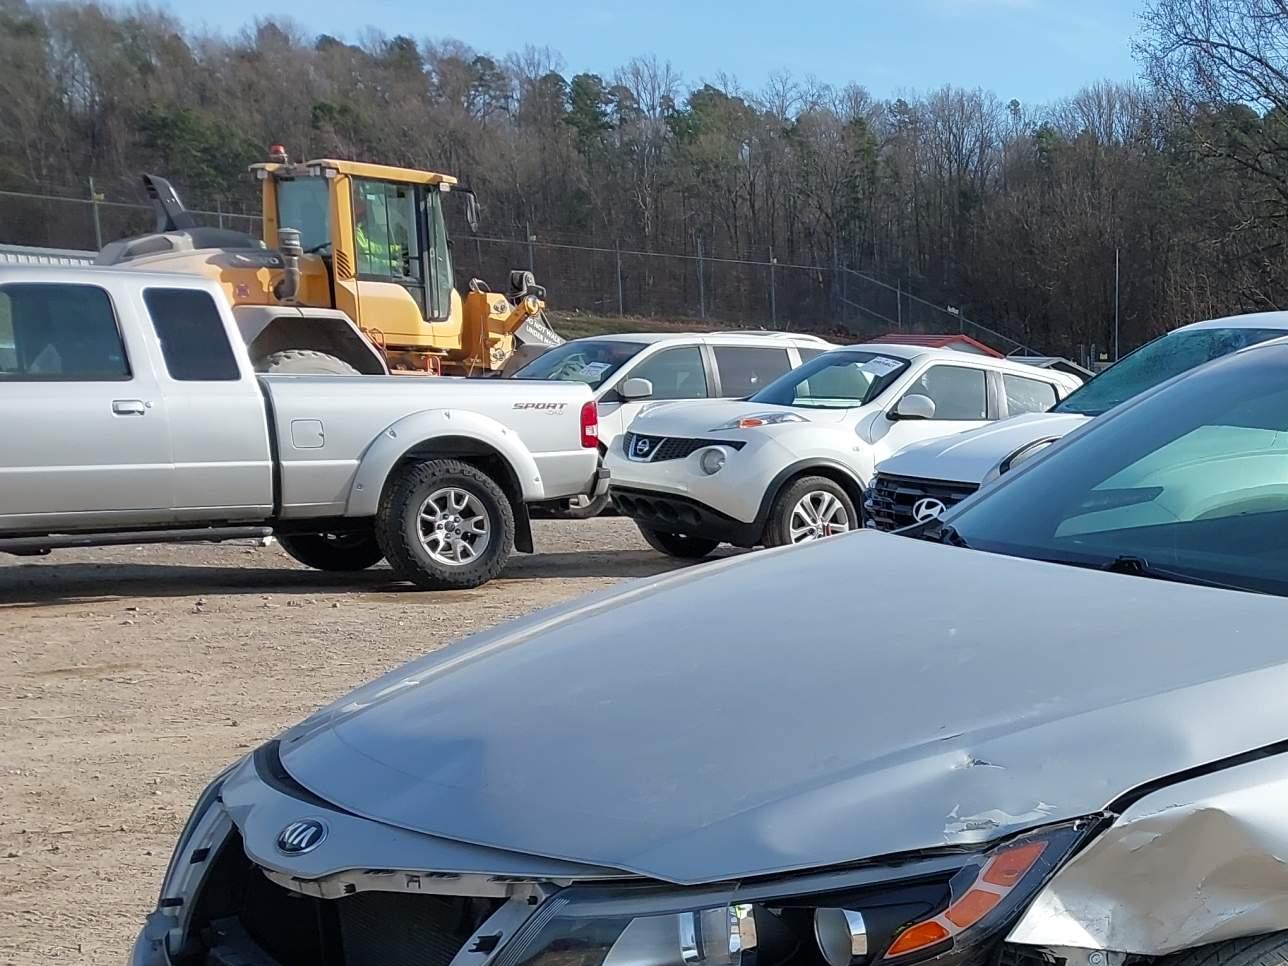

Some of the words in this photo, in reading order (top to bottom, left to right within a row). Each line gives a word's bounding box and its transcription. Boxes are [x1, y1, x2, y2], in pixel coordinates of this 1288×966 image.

[533, 321, 546, 334] NOT
[511, 402, 568, 410] SPORT
[280, 822, 317, 848] KIA
